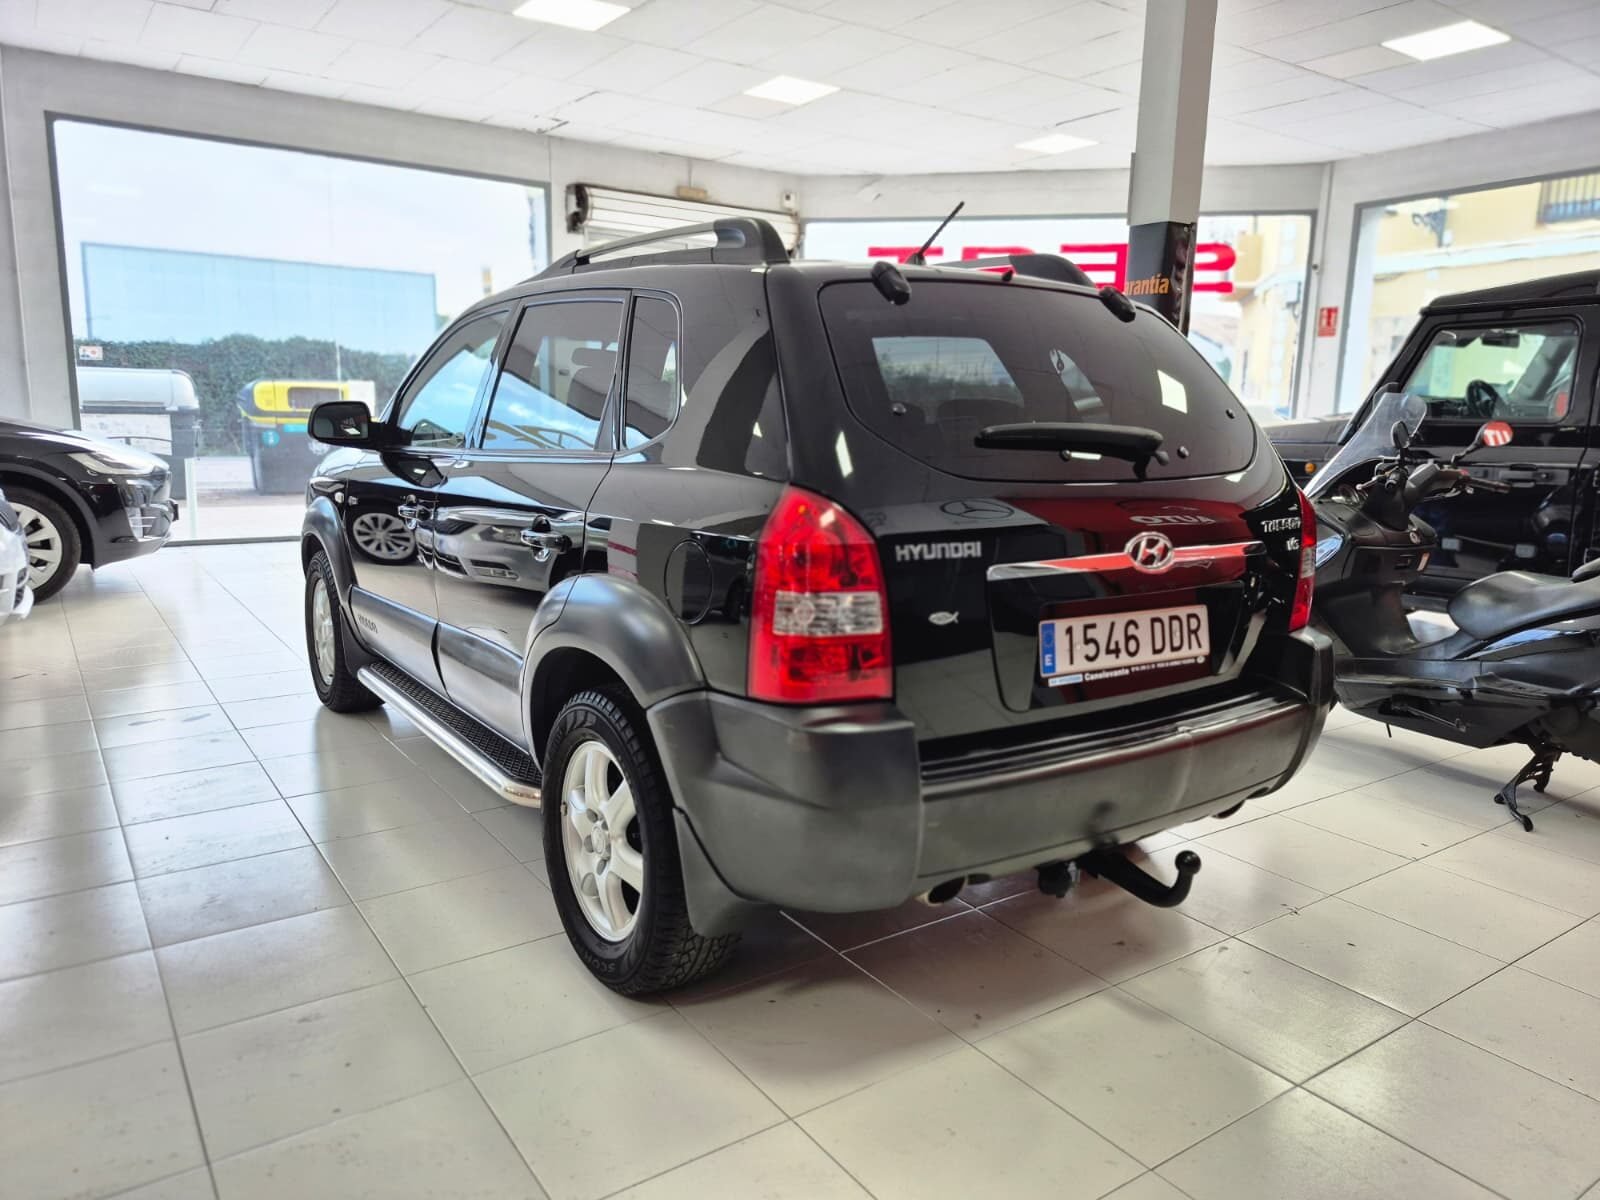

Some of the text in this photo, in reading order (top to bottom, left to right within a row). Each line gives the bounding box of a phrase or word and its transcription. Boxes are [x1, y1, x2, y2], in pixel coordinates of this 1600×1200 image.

[894, 541, 982, 562] HYUNDAI
[1065, 612, 1202, 666] 1546 DDR
